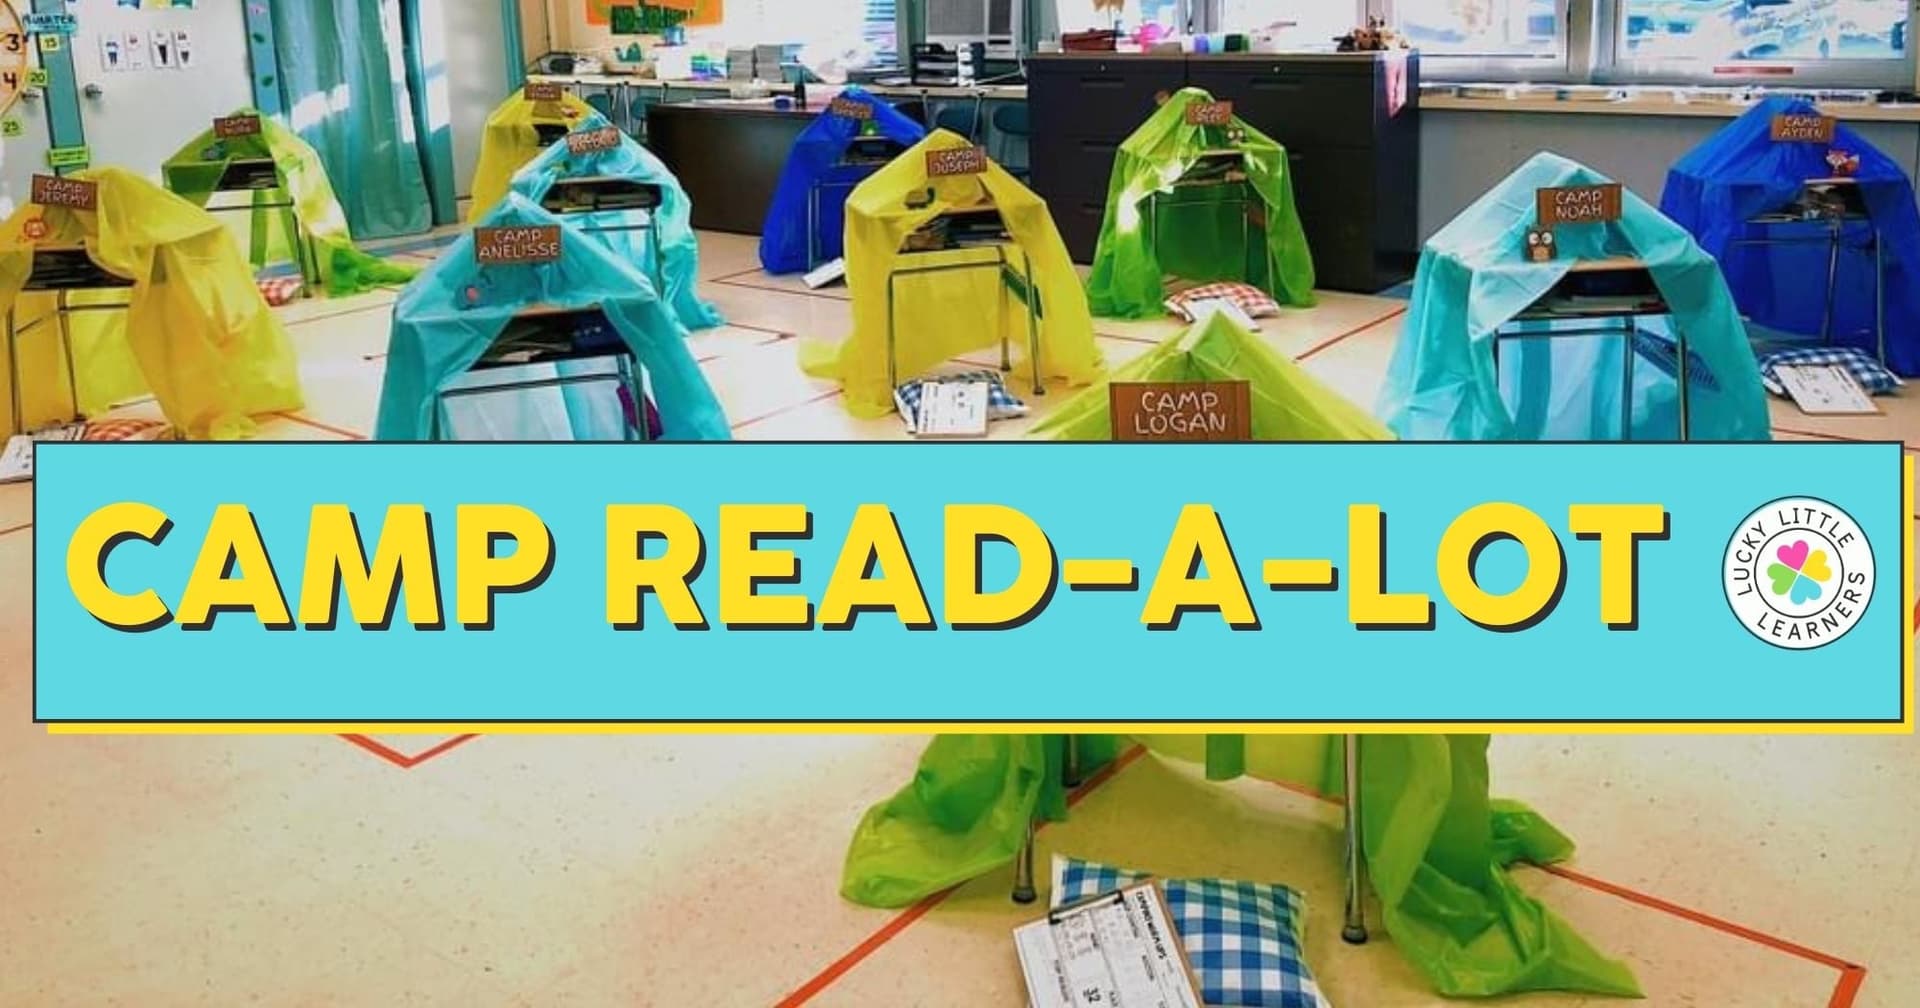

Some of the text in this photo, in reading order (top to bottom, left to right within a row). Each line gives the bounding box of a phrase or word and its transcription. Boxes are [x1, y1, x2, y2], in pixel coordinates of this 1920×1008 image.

[7, 33, 20, 51] 3
[45, 37, 58, 48] 15
[4, 72, 17, 90] 4
[30, 72, 46, 83] 20
[3, 121, 20, 133] 25
[1784, 115, 1822, 127] CAMP
[940, 150, 974, 163] CAMP
[930, 159, 980, 175] JOSEPH
[46, 179, 83, 193] CAMP
[40, 189, 90, 207] JEREMY
[1555, 188, 1602, 205] CAMP
[1555, 203, 1602, 219] NOAH
[495, 228, 542, 244] CAMP
[479, 241, 559, 259] ANELISSE
[1141, 390, 1219, 412] CAMP
[1134, 411, 1226, 435] LOGAN
